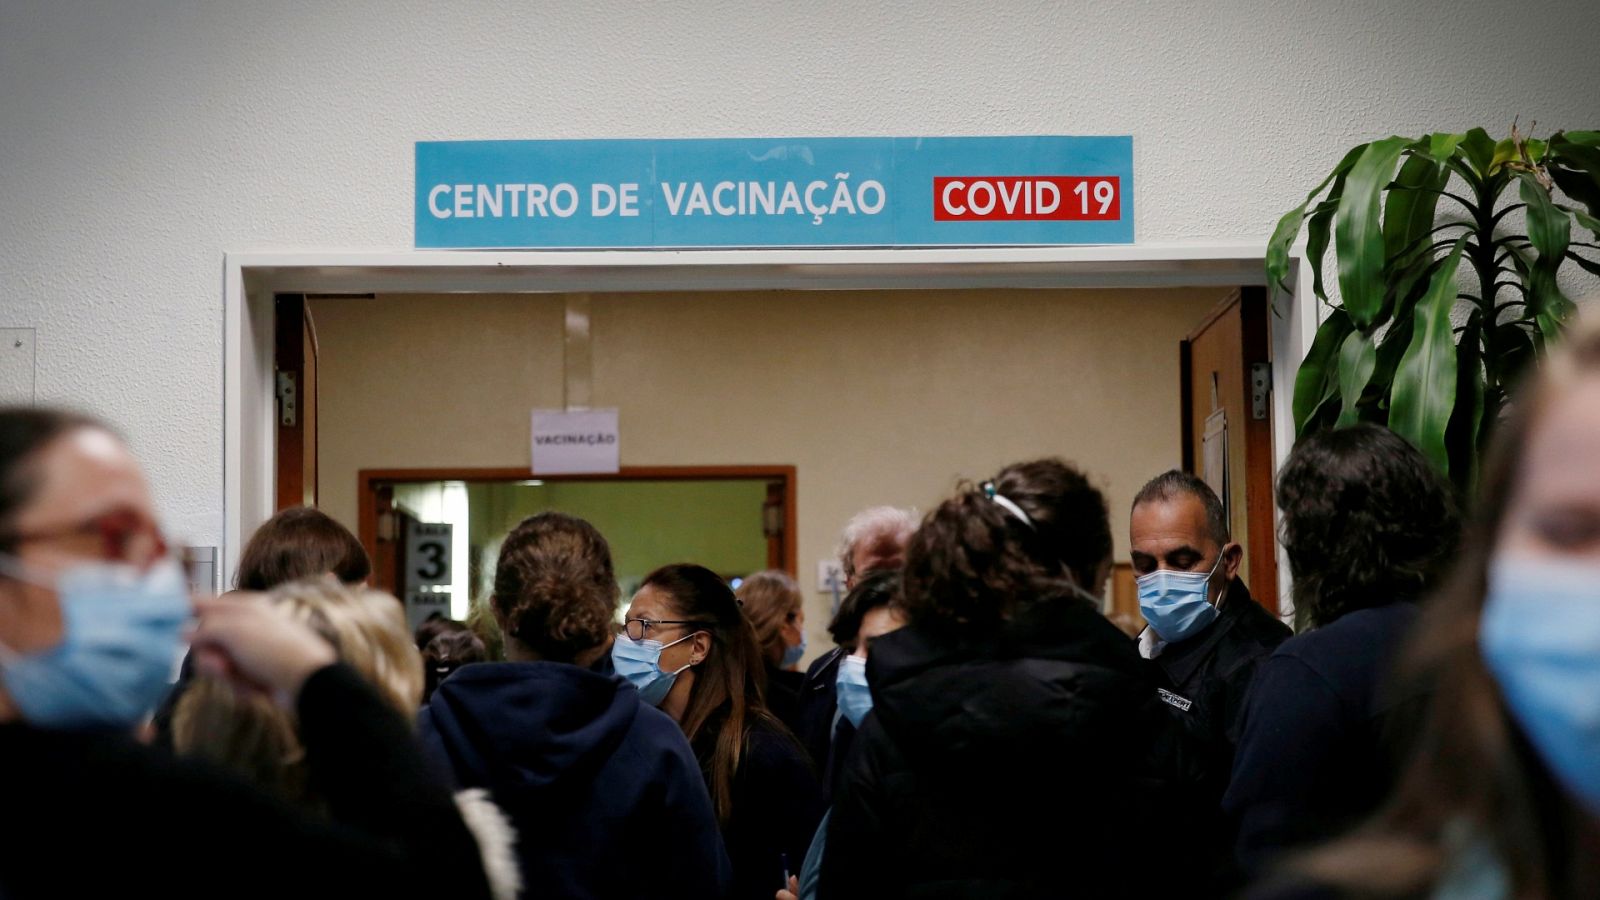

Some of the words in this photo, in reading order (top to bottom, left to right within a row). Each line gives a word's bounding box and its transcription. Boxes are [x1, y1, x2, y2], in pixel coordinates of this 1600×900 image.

[428, 182, 579, 219] CENTRO
[591, 183, 640, 218] DE
[661, 172, 886, 226] VACINAÇÃO
[941, 180, 1061, 217] COVID
[1072, 180, 1115, 216] 19
[535, 432, 616, 447] VACINAÇÃO
[417, 541, 447, 581] 3
